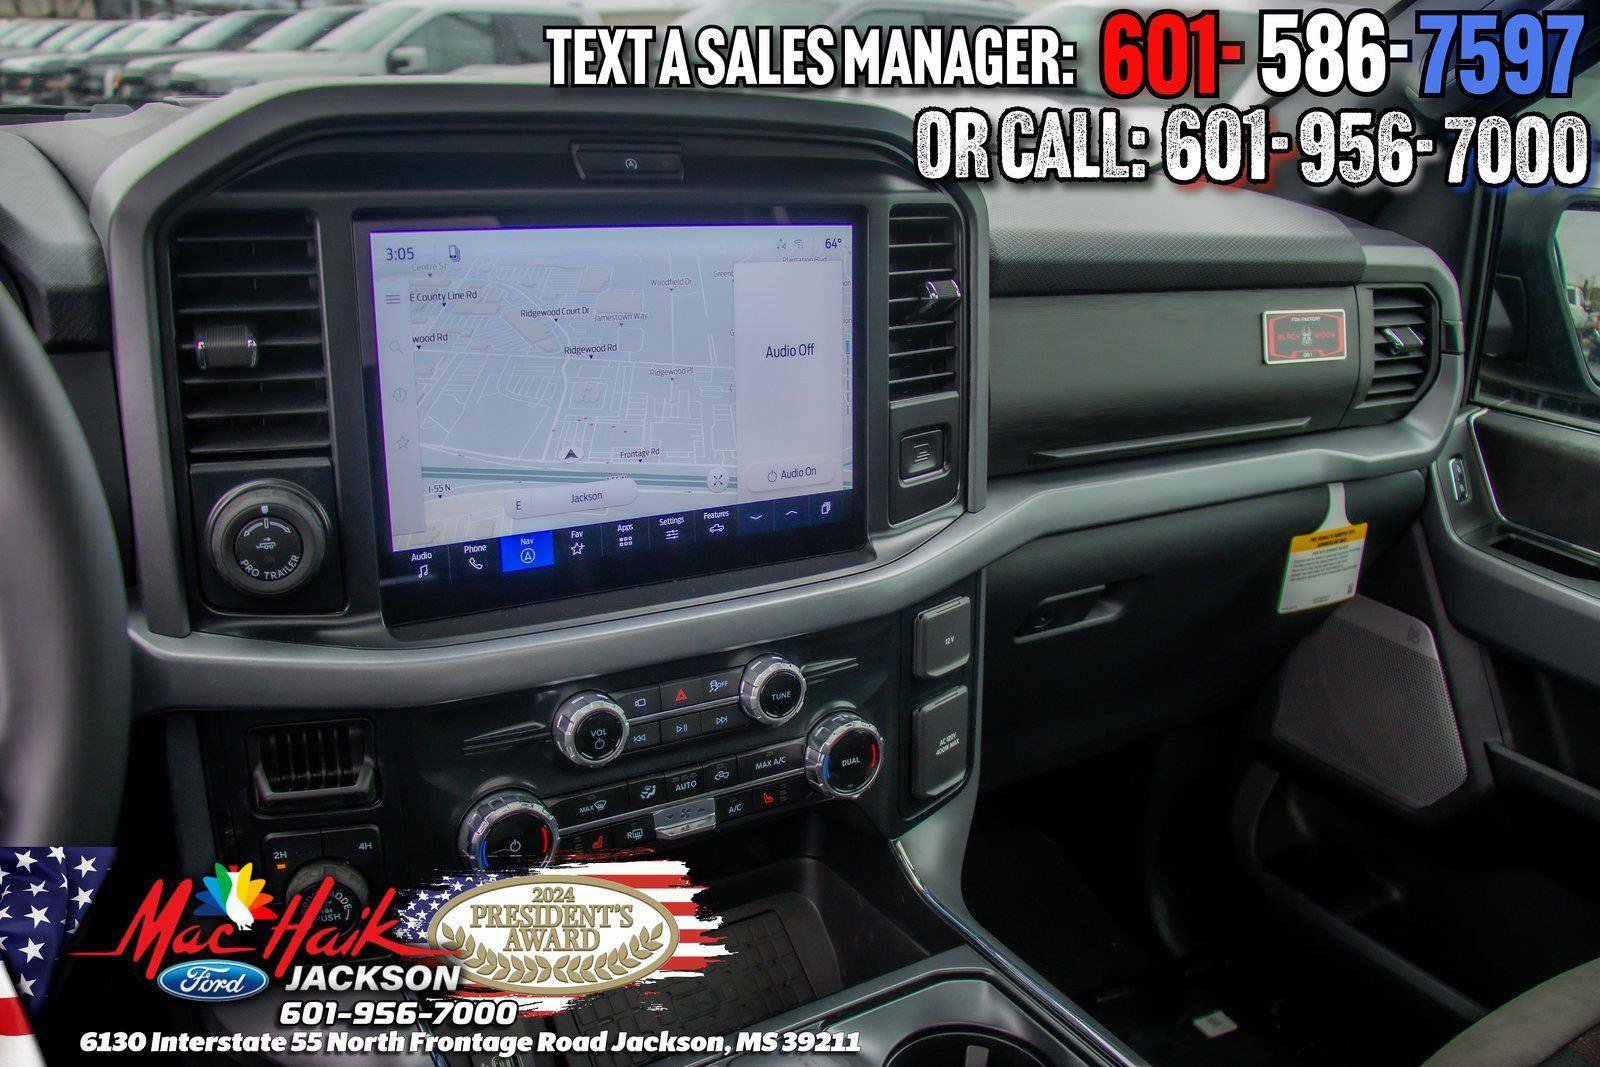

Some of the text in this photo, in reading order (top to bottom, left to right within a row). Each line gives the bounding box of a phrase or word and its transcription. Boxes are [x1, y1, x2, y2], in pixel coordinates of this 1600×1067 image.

[386, 247, 415, 261] 3:05
[411, 262, 440, 272] Centre
[650, 277, 683, 287] Woodfield
[416, 292, 446, 304] County
[447, 291, 465, 301] Line
[466, 290, 477, 300] Rd
[520, 306, 590, 319] Ridgewood Court Dr
[594, 312, 648, 323] Jamestown Way
[412, 333, 448, 344] wood Rd
[564, 344, 618, 356] Ridgewood Rd
[765, 343, 815, 359] Audio Off
[650, 367, 685, 378] Ridgewood
[620, 448, 660, 460] Frontage Rd
[781, 466, 817, 480] Audio On
[428, 484, 451, 494] I-55 N
[516, 492, 603, 511] E Jackson
[703, 510, 730, 520] Features
[659, 516, 685, 528] Settings
[617, 524, 634, 534] Apps
[571, 530, 584, 540] Fav
[520, 537, 535, 547] Nav
[463, 544, 487, 555] Phone
[411, 552, 433, 562] Audio
[241, 554, 300, 580] PRO TRAILER
[771, 690, 791, 701] TUNE
[591, 729, 607, 737] VOL
[755, 756, 787, 770] MAX A/C
[841, 757, 860, 767] DUAL
[675, 780, 697, 792] AUTO
[579, 805, 594, 814] MAX
[728, 804, 743, 814] A/C
[358, 842, 373, 850] 4H
[273, 851, 288, 859] 2H
